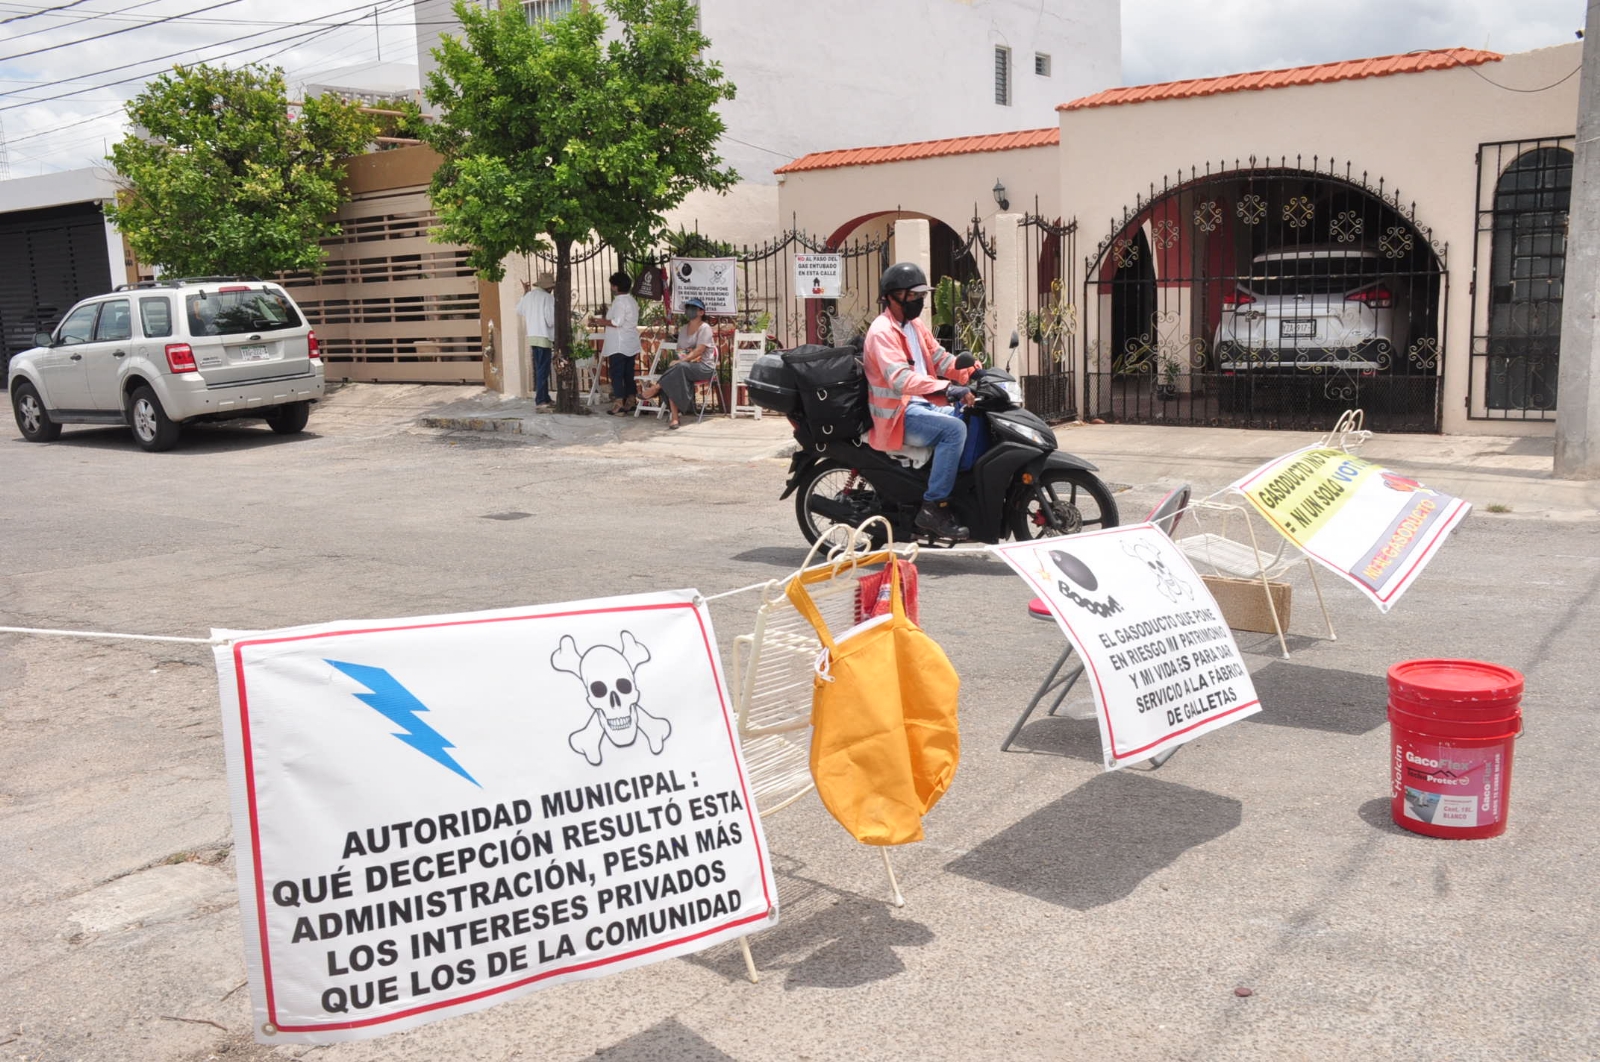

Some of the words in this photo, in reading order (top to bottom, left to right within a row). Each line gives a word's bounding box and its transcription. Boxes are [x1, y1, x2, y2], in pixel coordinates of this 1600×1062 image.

[1258, 461, 1315, 509] GASODUCTO
[1290, 510, 1307, 528] NI
[1307, 495, 1325, 520] UN
[1316, 479, 1345, 507] SOLO
[1381, 498, 1437, 558] GASODUCTO
[1099, 629, 1115, 649] EL
[1116, 619, 1176, 646] GASODUCTO
[1177, 613, 1195, 632] QUE
[1193, 608, 1217, 626] PONE
[1110, 654, 1127, 671] EN
[1128, 640, 1167, 666] RIESGO
[1168, 636, 1179, 653] MI
[1181, 626, 1227, 652] PATRIMONIO
[1129, 674, 1140, 689] Y
[1140, 669, 1155, 687] MI
[1155, 661, 1179, 682] VIDA
[1179, 655, 1191, 674] ES
[1194, 650, 1217, 670] PARA
[1217, 646, 1234, 661] DAR
[1136, 683, 1183, 714] SERVICIO
[1184, 683, 1192, 696] A
[1191, 674, 1208, 692] LA
[1210, 662, 1244, 687] FÁBRICA
[1167, 708, 1182, 726] DE
[1184, 687, 1238, 719] GALLETAS
[1394, 745, 1403, 791] Holcim
[1405, 751, 1469, 771] GacoFlex
[1481, 762, 1492, 811] GacoFlex
[343, 798, 532, 859] AUTORIDAD
[541, 769, 685, 820] MUNICIPAL
[690, 770, 699, 789] :
[272, 866, 353, 909] QUÉ
[366, 830, 553, 893] DECEPCIÓN
[564, 798, 682, 850] RESULTÓ
[689, 788, 744, 825] ESTA
[291, 858, 598, 944] ADMINISTRACIÓN,
[604, 837, 690, 877] PESAN
[696, 820, 744, 855] MÁS
[327, 940, 398, 977] LOS
[411, 896, 589, 960] INTERESES
[598, 859, 727, 915] PRIVADOS
[321, 976, 399, 1014] QUE
[411, 958, 477, 997] LOS
[487, 947, 528, 977] DE
[538, 933, 577, 962] LA
[584, 888, 743, 949] COMUNIDAD
